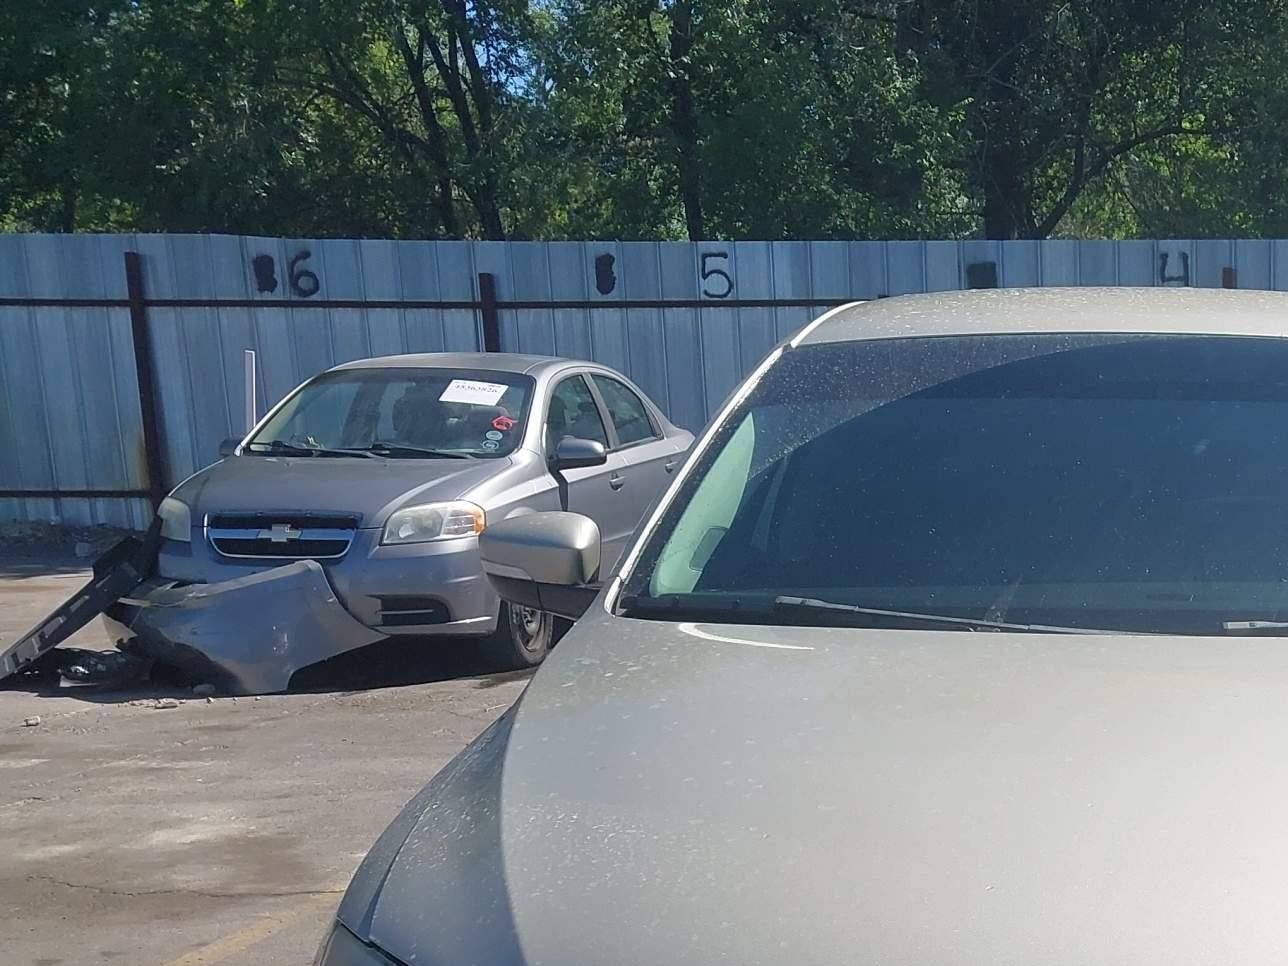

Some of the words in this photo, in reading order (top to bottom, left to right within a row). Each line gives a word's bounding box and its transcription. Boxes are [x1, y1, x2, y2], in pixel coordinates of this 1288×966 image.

[290, 250, 320, 298] 6
[701, 252, 734, 299] 5
[1160, 251, 1190, 288] 4
